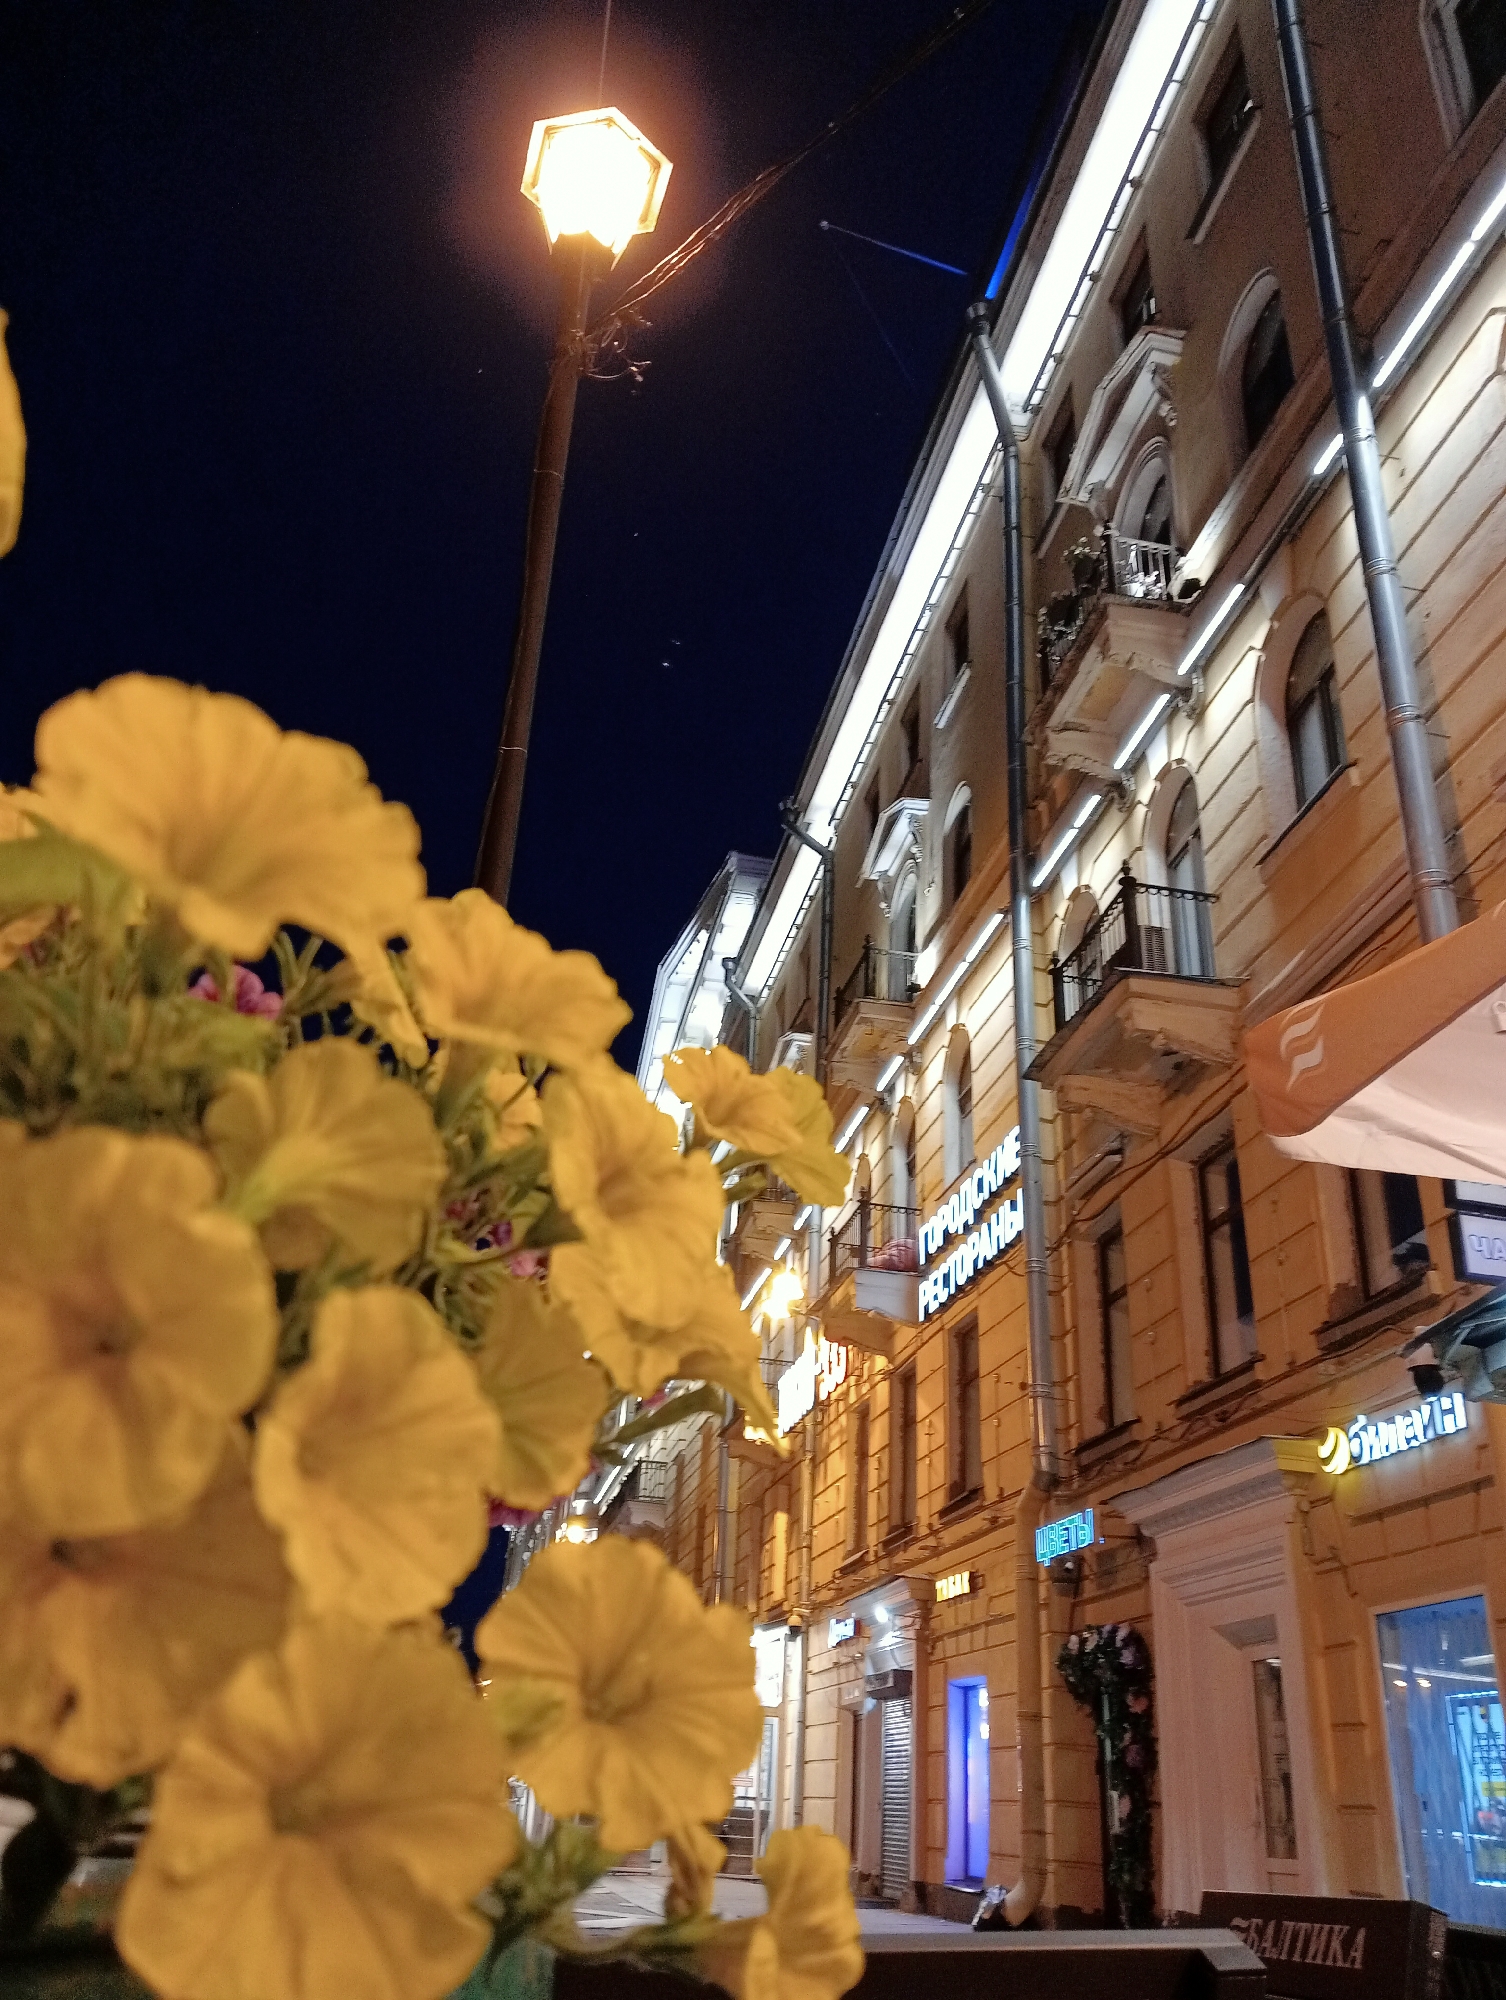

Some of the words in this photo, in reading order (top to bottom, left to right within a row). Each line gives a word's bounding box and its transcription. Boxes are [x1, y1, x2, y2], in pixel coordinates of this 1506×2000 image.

[918, 1125, 1021, 1265] ГОРОДСКИЕ
[918, 1188, 1024, 1322] РЕСТОРАНЫ
[1035, 1508, 1094, 1567] ЦВЕТЫ
[1235, 1917, 1366, 1969] БАЛТИКА
